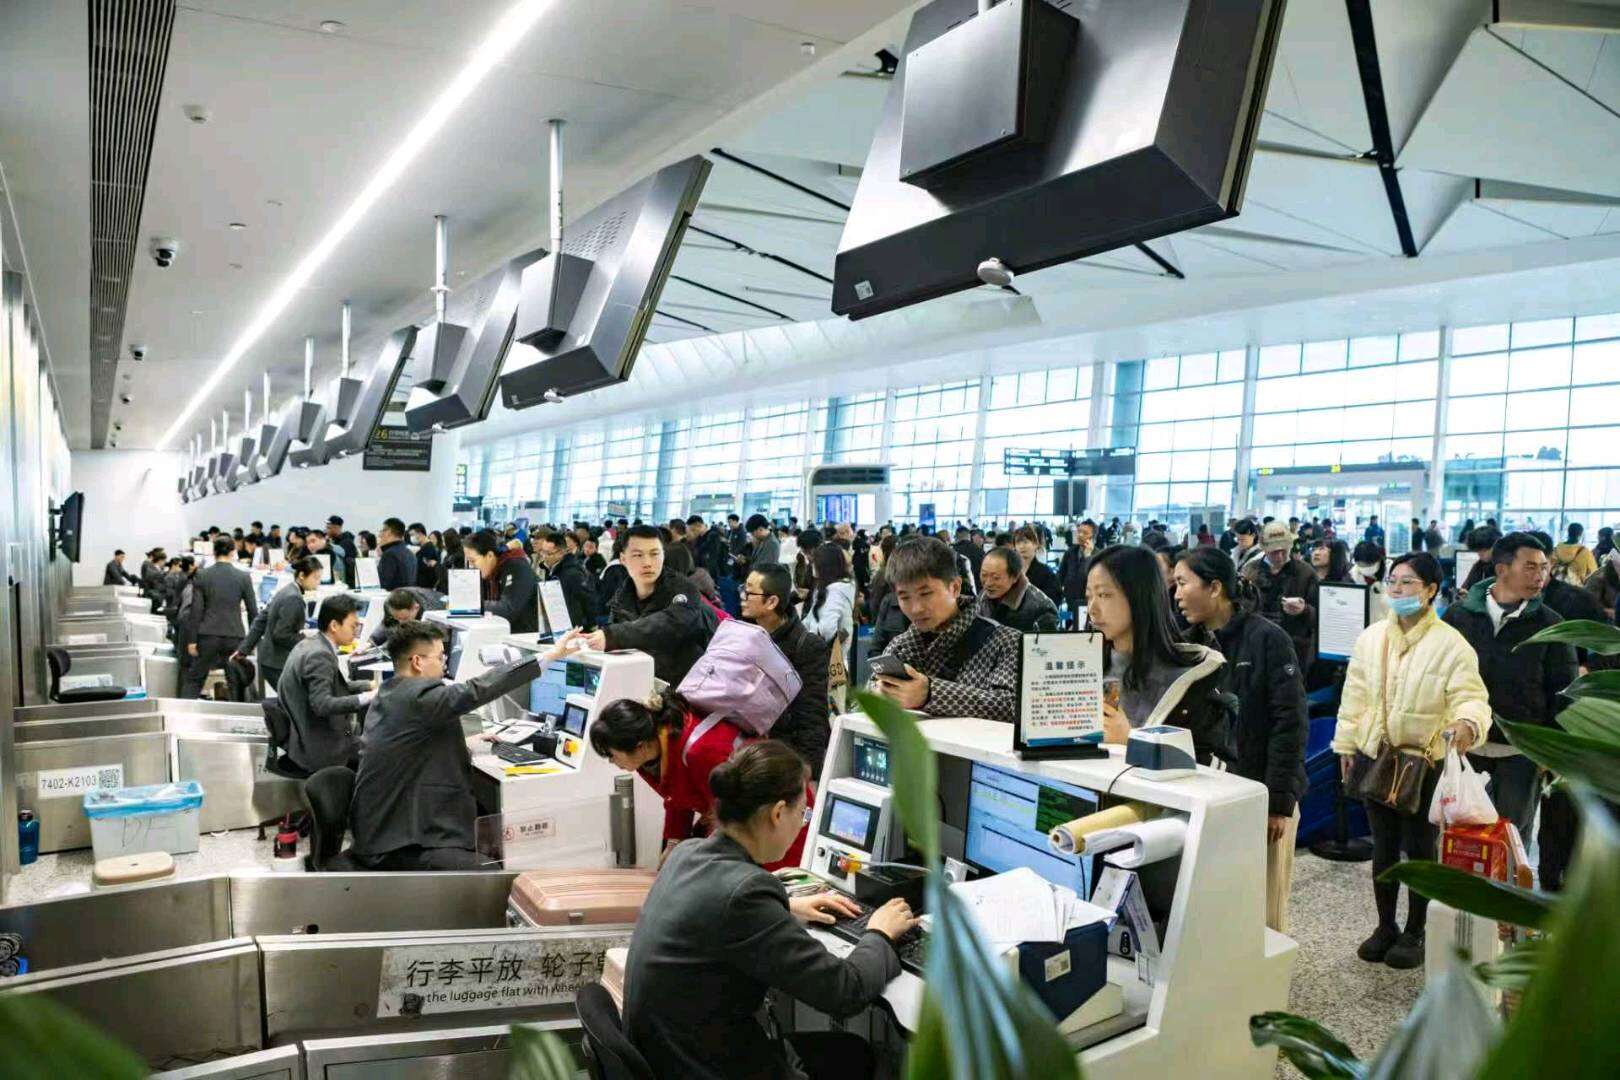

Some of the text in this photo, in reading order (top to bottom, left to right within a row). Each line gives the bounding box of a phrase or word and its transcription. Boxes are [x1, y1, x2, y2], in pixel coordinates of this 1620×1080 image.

[41, 775, 97, 790] 7402-K2103
[406, 954, 524, 988] 行李平放
[426, 992, 447, 1003] the
[450, 988, 498, 1003] luggage
[501, 986, 520, 998] flat
[523, 983, 549, 997] with
